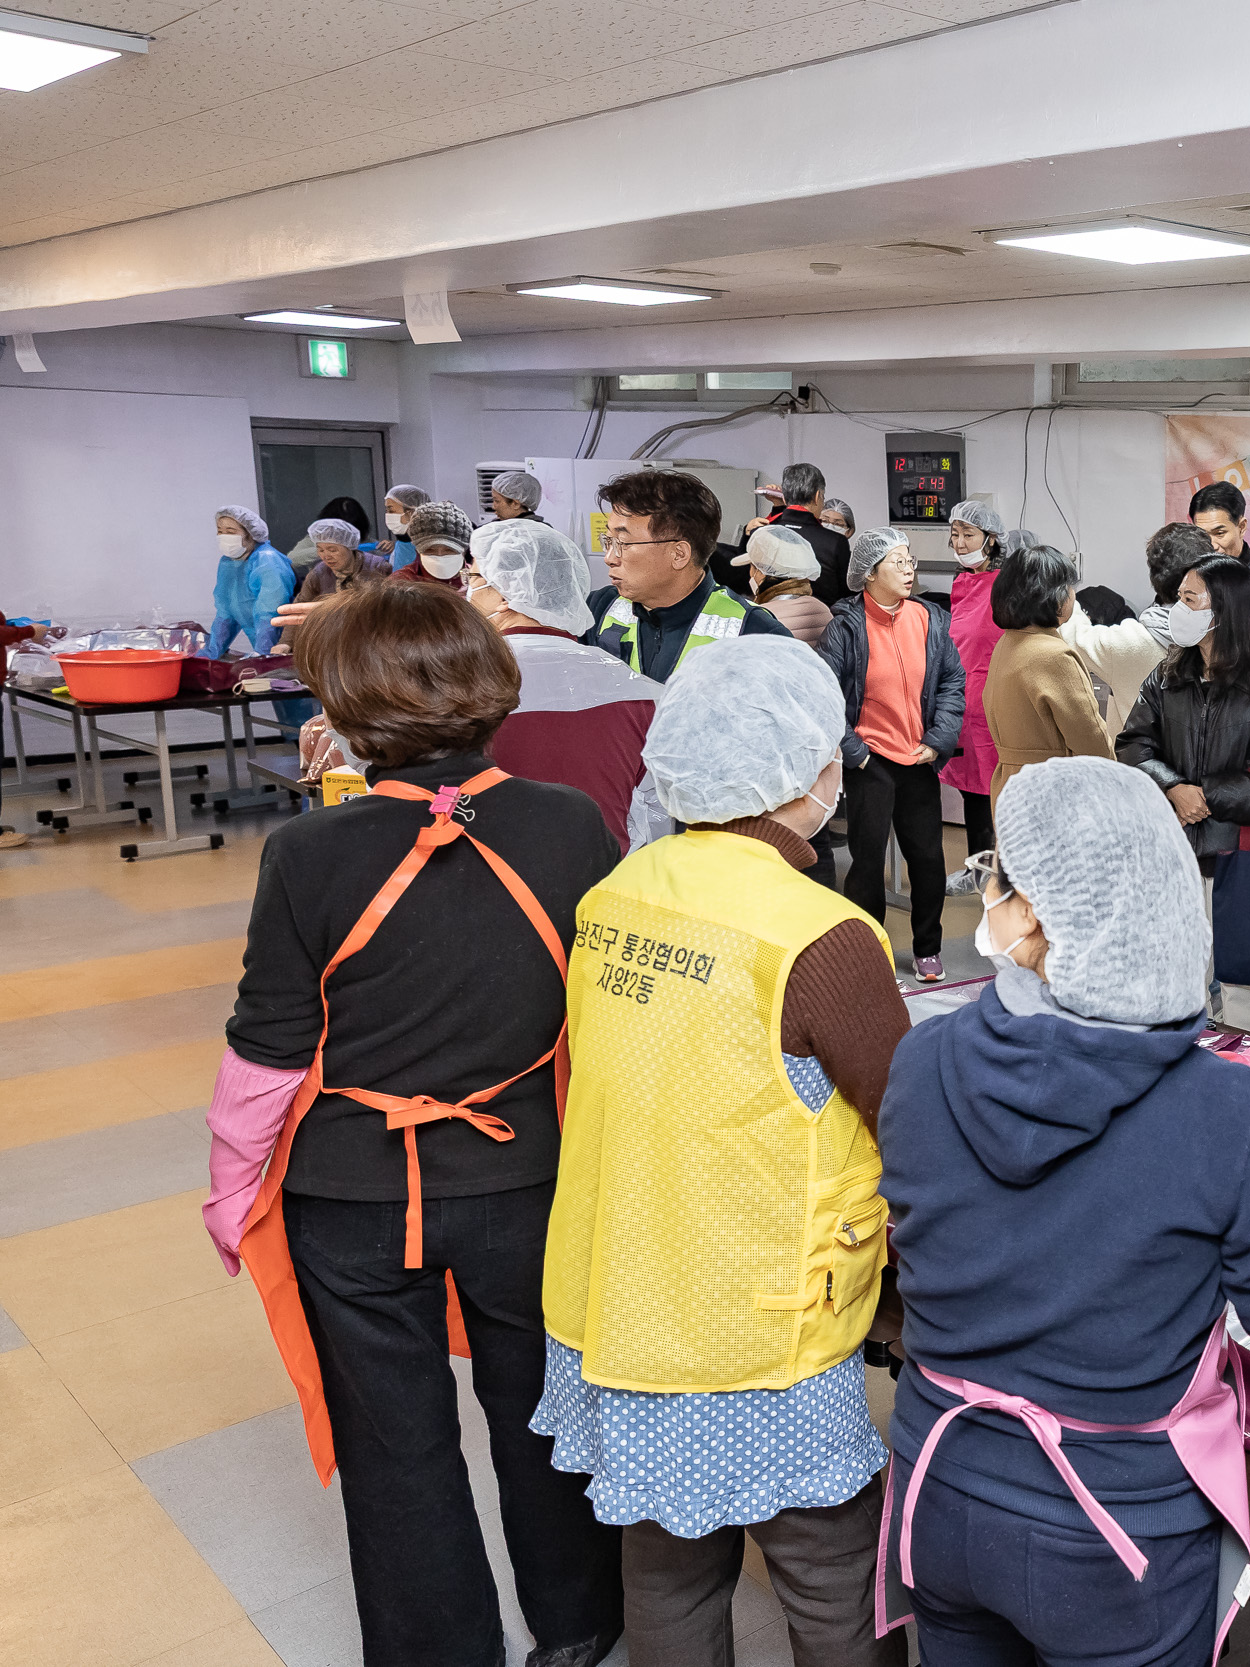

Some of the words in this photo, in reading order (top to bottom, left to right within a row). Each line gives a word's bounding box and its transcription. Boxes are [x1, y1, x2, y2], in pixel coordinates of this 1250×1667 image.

[576, 920, 620, 954] 광진구
[621, 933, 716, 985] 통장협의회
[596, 962, 656, 1004] 자양2동
